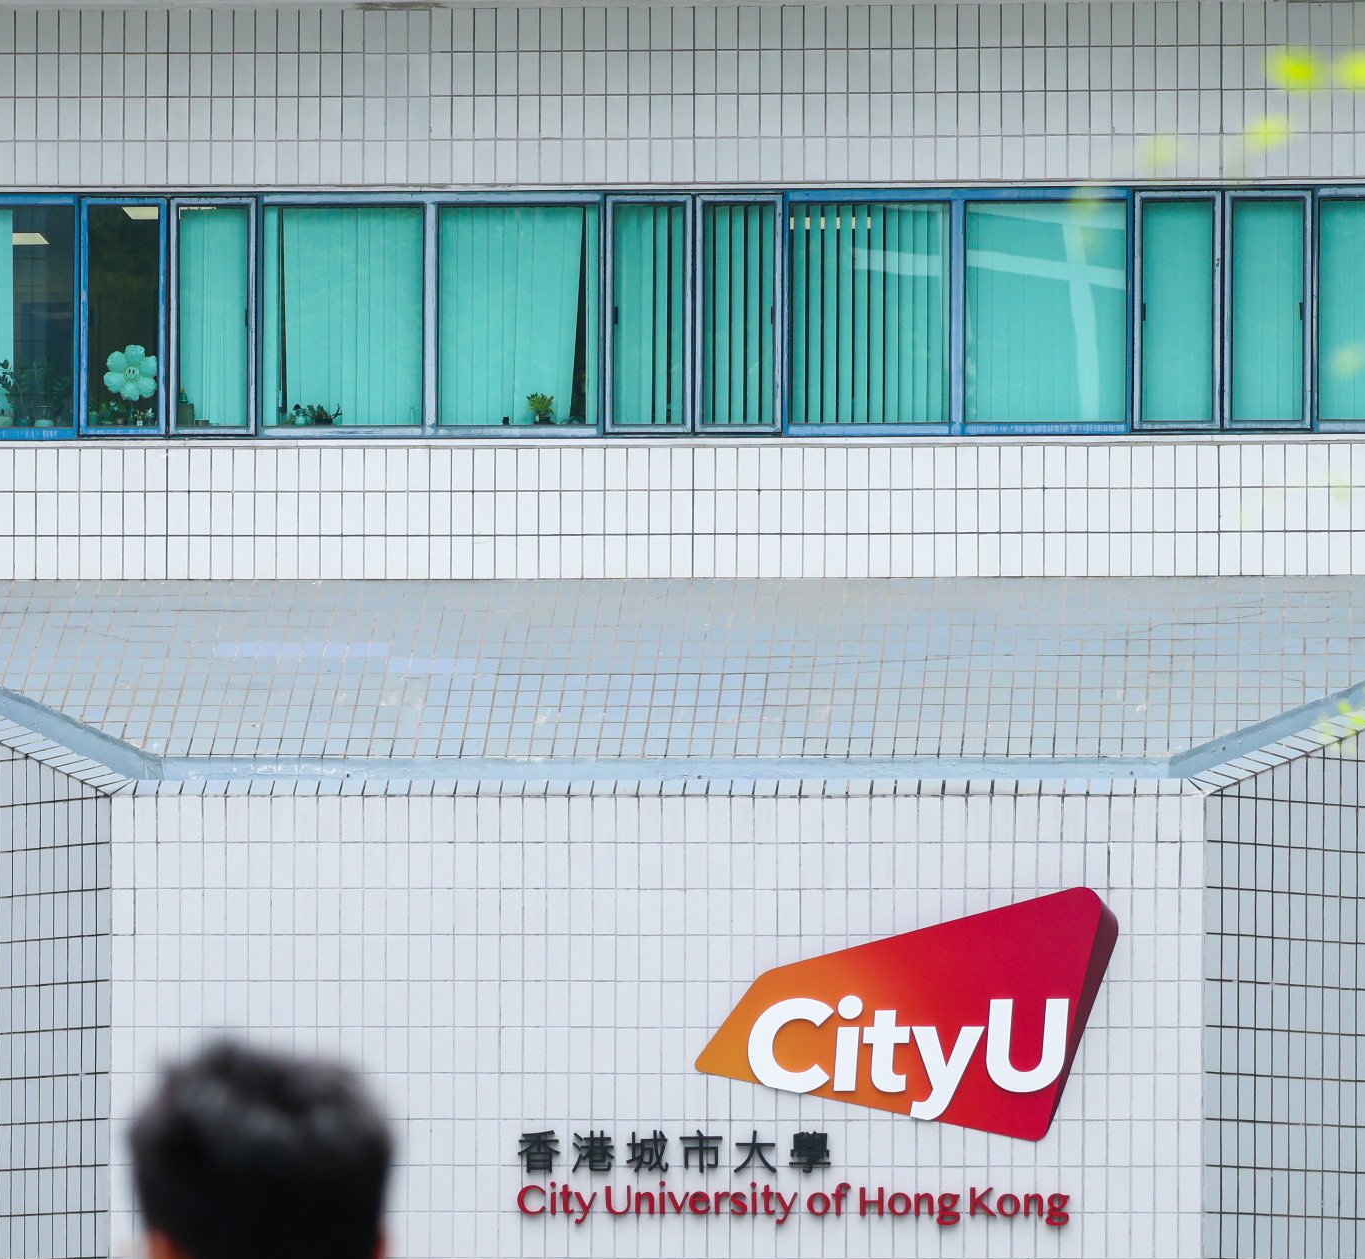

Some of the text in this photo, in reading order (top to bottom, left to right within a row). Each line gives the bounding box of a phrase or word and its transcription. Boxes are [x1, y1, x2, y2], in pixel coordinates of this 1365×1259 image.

[747, 995, 1069, 1120] CityU
[517, 1129, 831, 1174] 香港城市大學
[517, 1181, 1071, 1227] City University of Hong Kong
